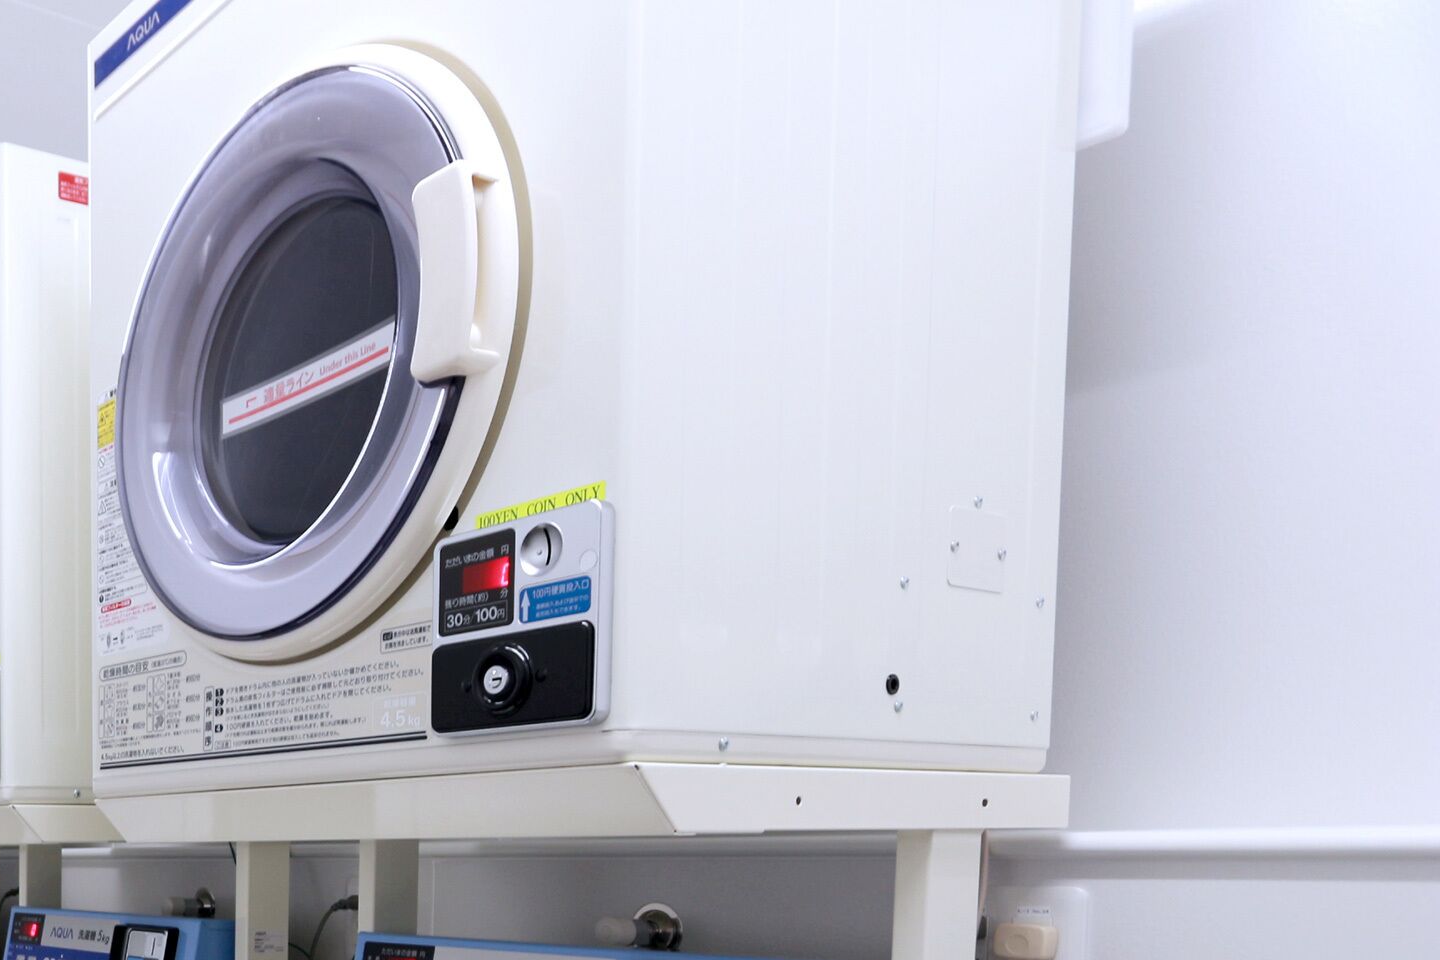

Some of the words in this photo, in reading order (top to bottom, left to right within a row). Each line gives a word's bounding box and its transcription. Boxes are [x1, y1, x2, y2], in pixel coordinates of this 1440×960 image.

[127, 11, 160, 51] AQUA
[319, 359, 343, 376] Under
[344, 350, 358, 364] this
[360, 342, 376, 357] Line
[526, 497, 556, 515] COIN
[565, 484, 600, 505] ONLY
[500, 544, 509, 556] 円
[50, 927, 73, 940] AQUA
